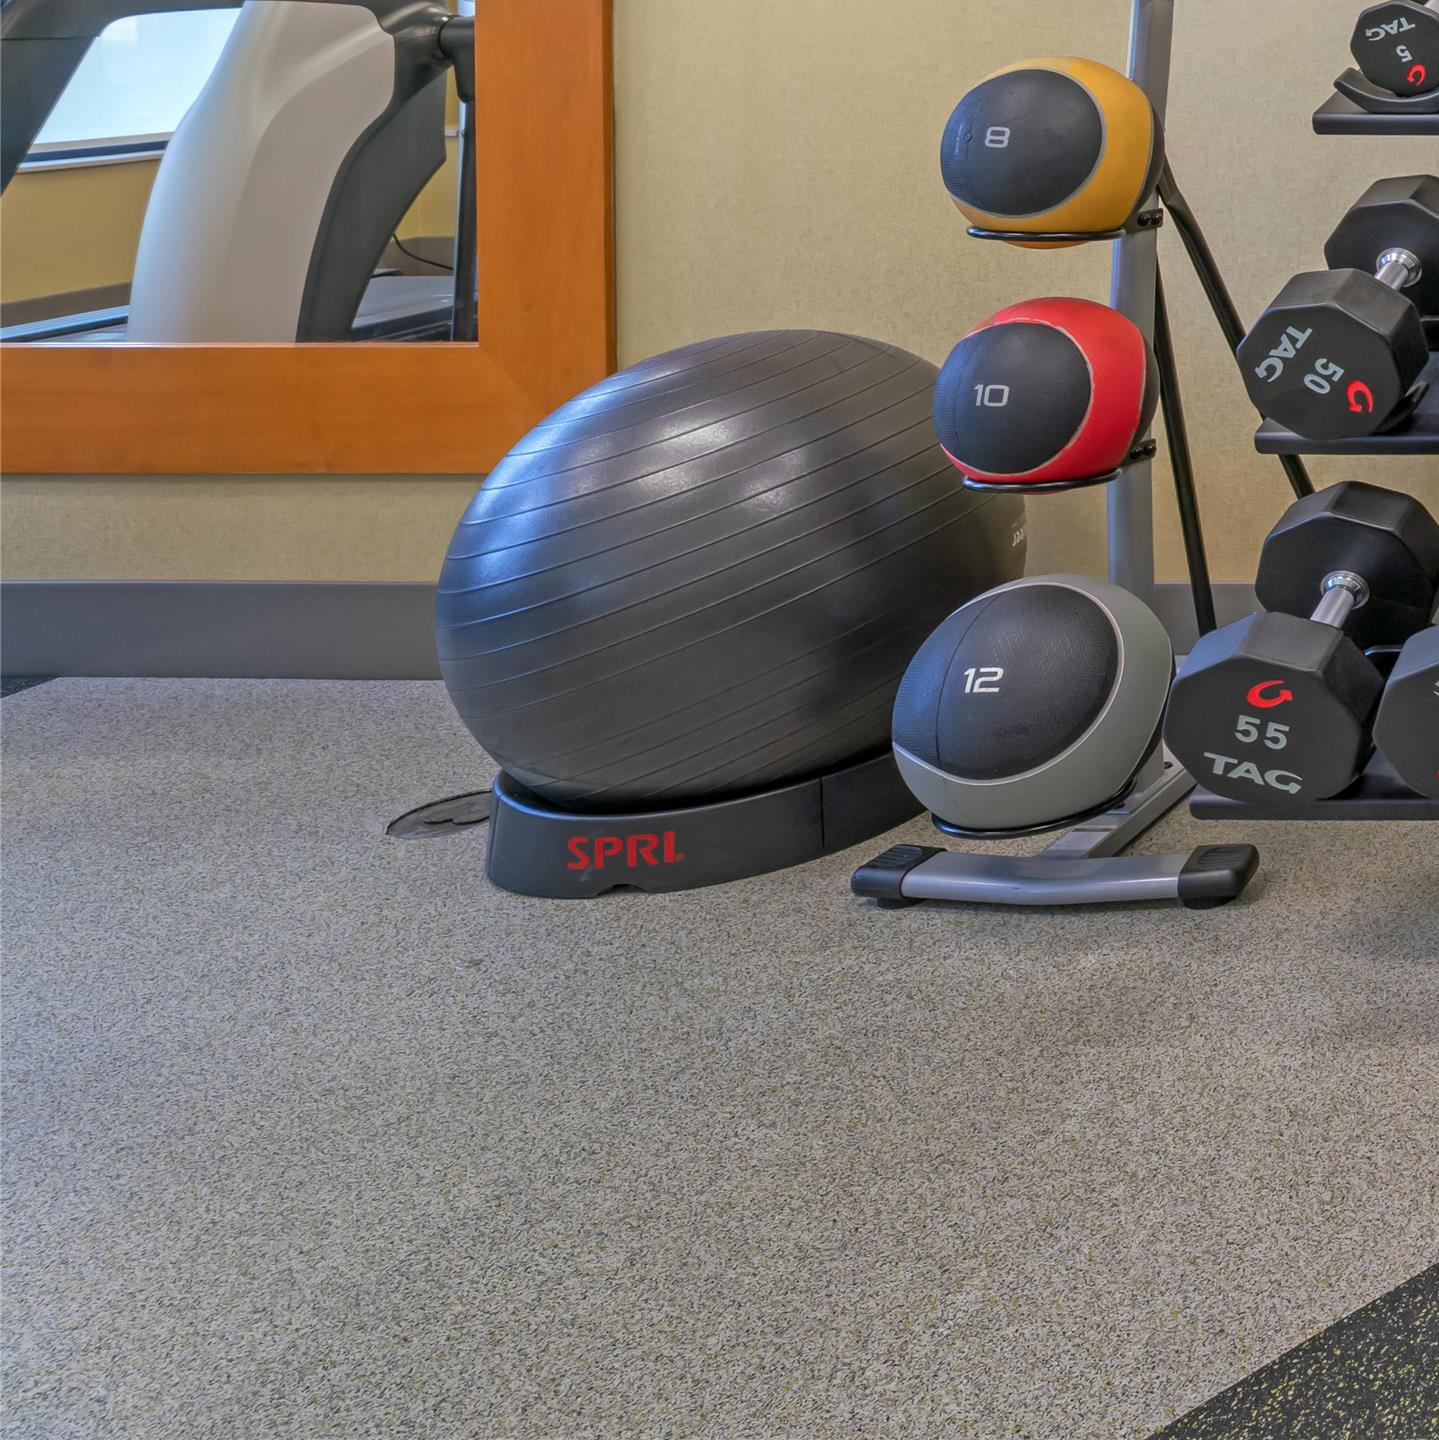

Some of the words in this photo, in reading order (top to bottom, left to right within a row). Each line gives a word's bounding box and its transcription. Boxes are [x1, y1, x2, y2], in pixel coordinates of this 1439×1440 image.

[1365, 16, 1416, 41] TAG
[1395, 45, 1413, 63] 5
[985, 127, 1010, 147] 8
[975, 384, 1009, 406] 10
[964, 667, 1003, 693] 12
[1234, 714, 1290, 750] 55
[1203, 751, 1304, 795] TAG
[566, 831, 676, 870] SPRI
